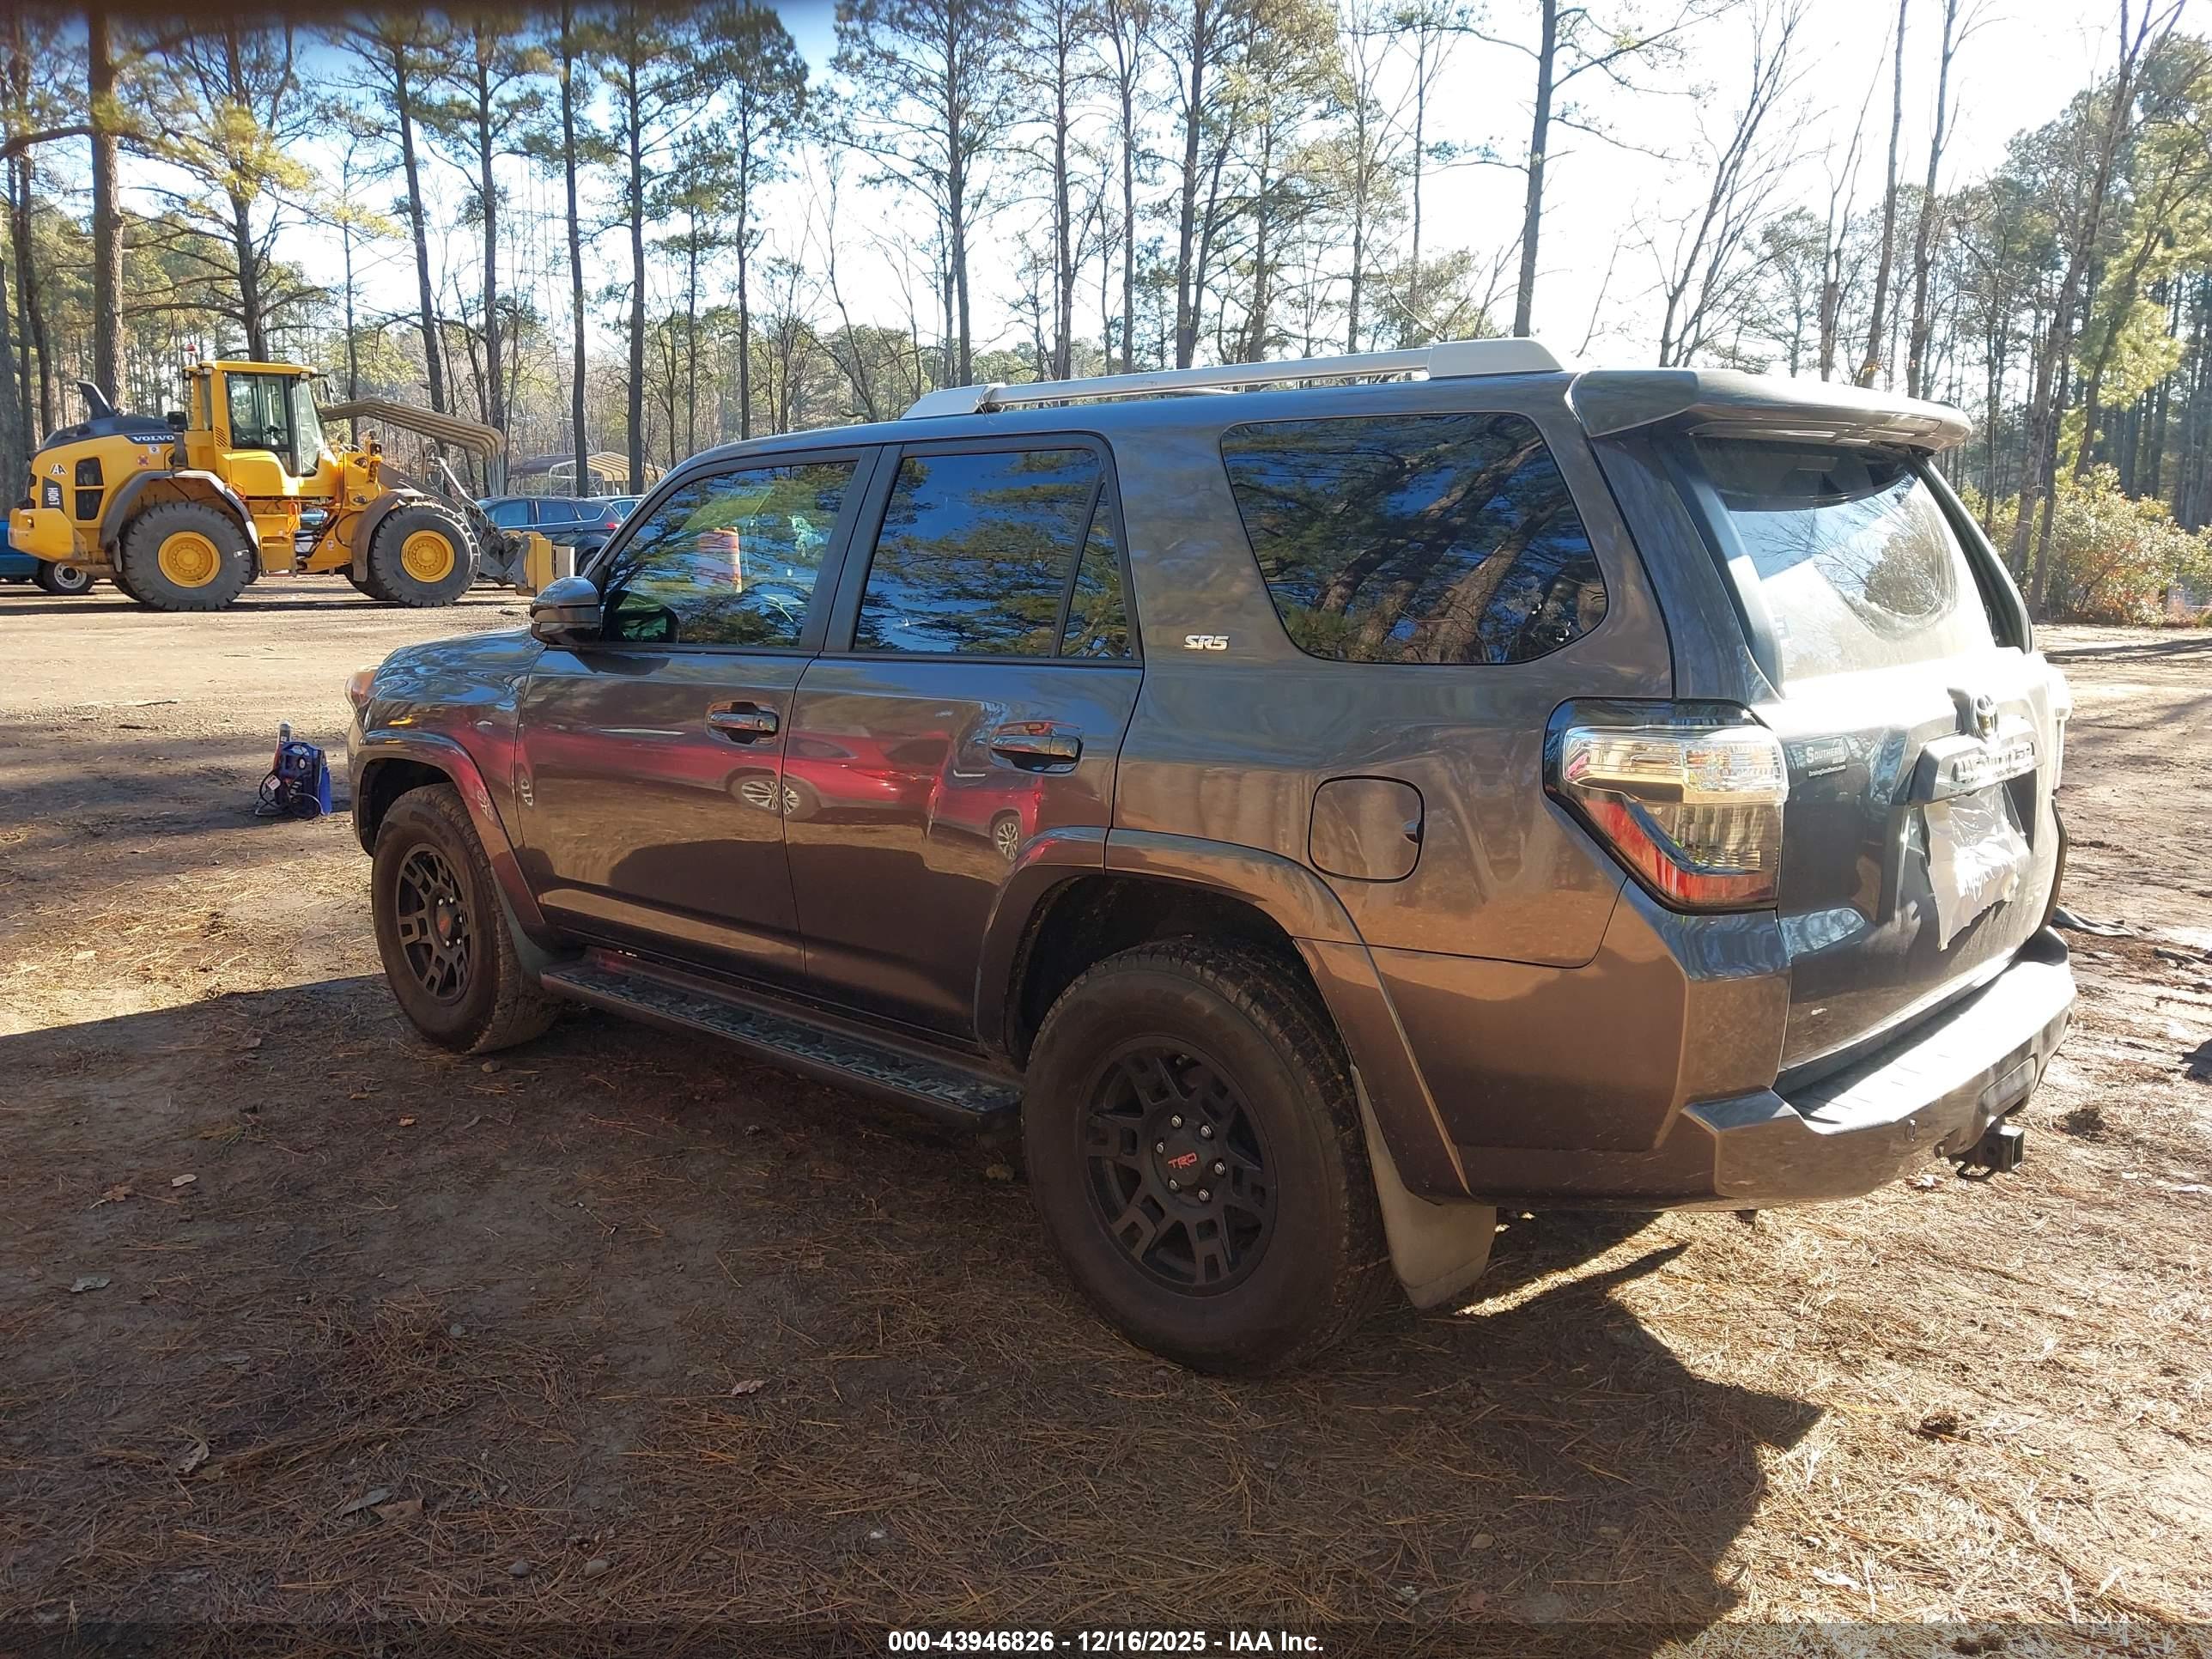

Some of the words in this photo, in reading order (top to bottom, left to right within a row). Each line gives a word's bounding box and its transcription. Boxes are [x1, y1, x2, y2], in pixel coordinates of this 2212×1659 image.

[47, 487, 60, 506] L90H
[1183, 635, 1230, 651] SR5
[1167, 1152, 1197, 1170] TRD
